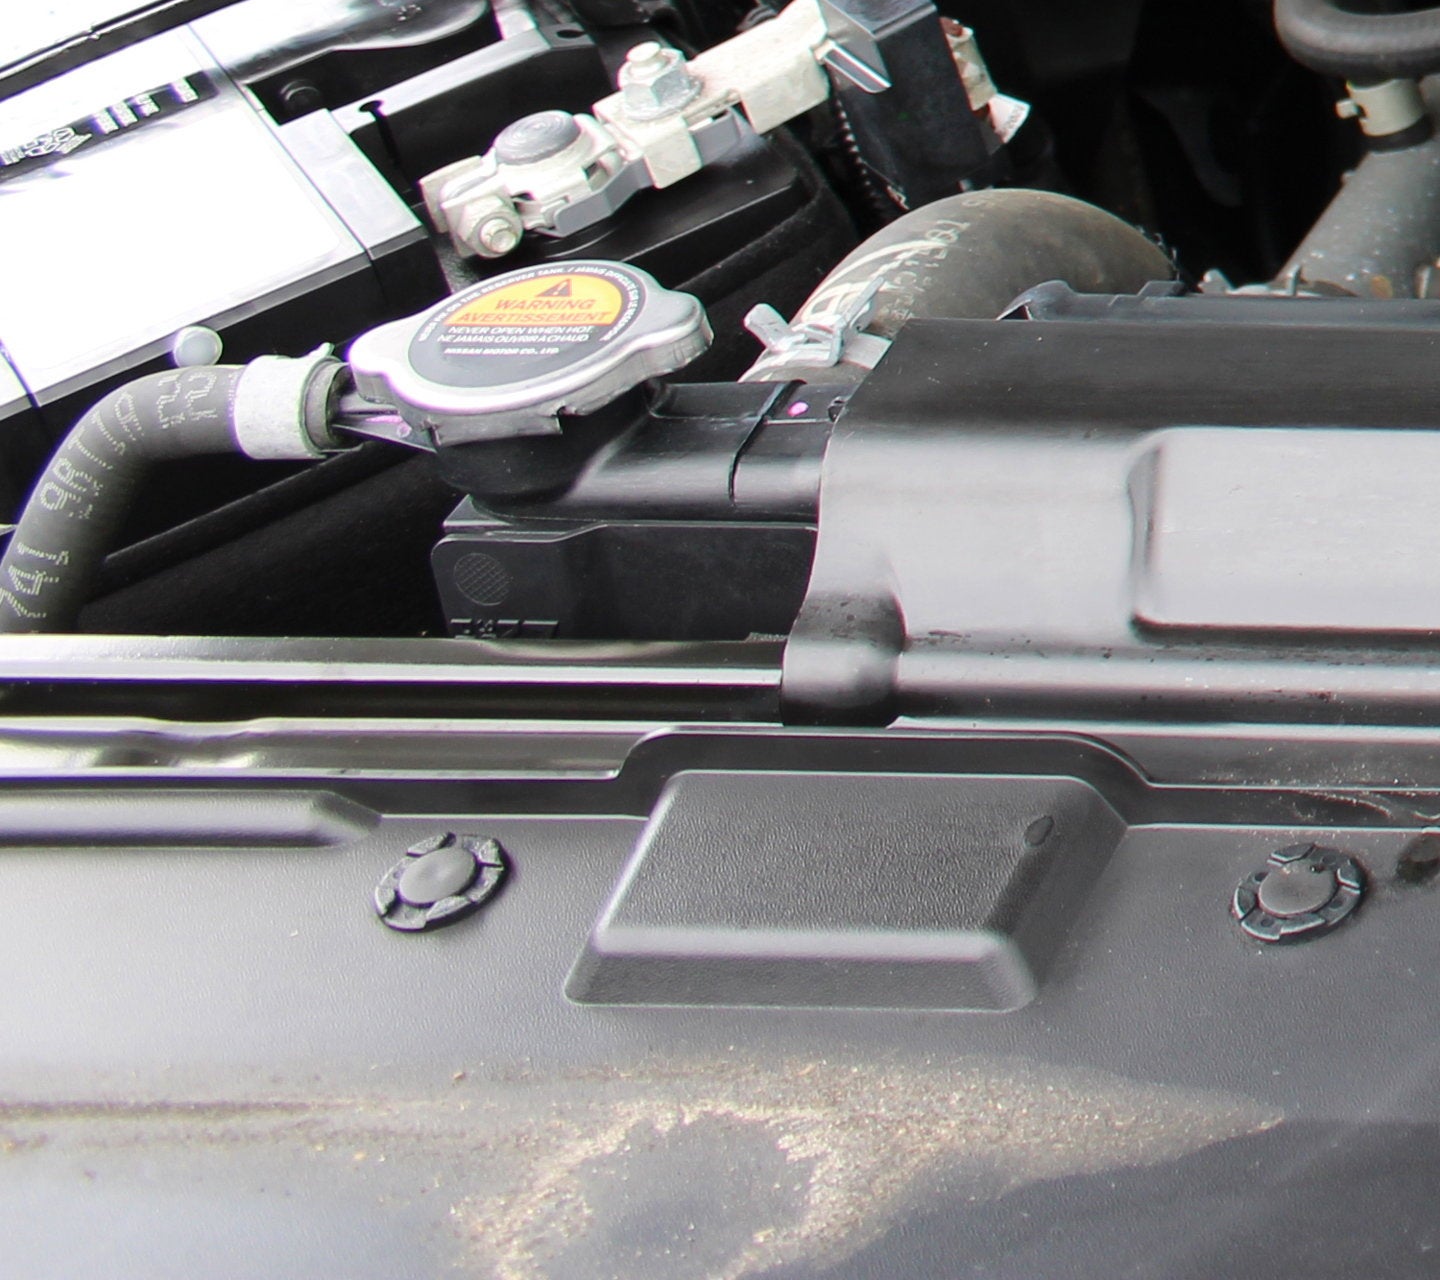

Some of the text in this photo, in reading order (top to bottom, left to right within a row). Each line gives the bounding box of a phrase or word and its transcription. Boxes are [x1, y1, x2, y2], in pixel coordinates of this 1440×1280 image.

[495, 299, 597, 310] WARNING
[457, 312, 613, 323] AVERTISSEMENT
[448, 326, 490, 334] NEVER
[490, 326, 525, 334] OPEN
[527, 326, 567, 334] WHEN
[437, 334, 455, 343] NE
[453, 334, 495, 343] JAMAIS
[547, 334, 590, 343] CHAUD
[443, 347, 481, 355] NISSAN
